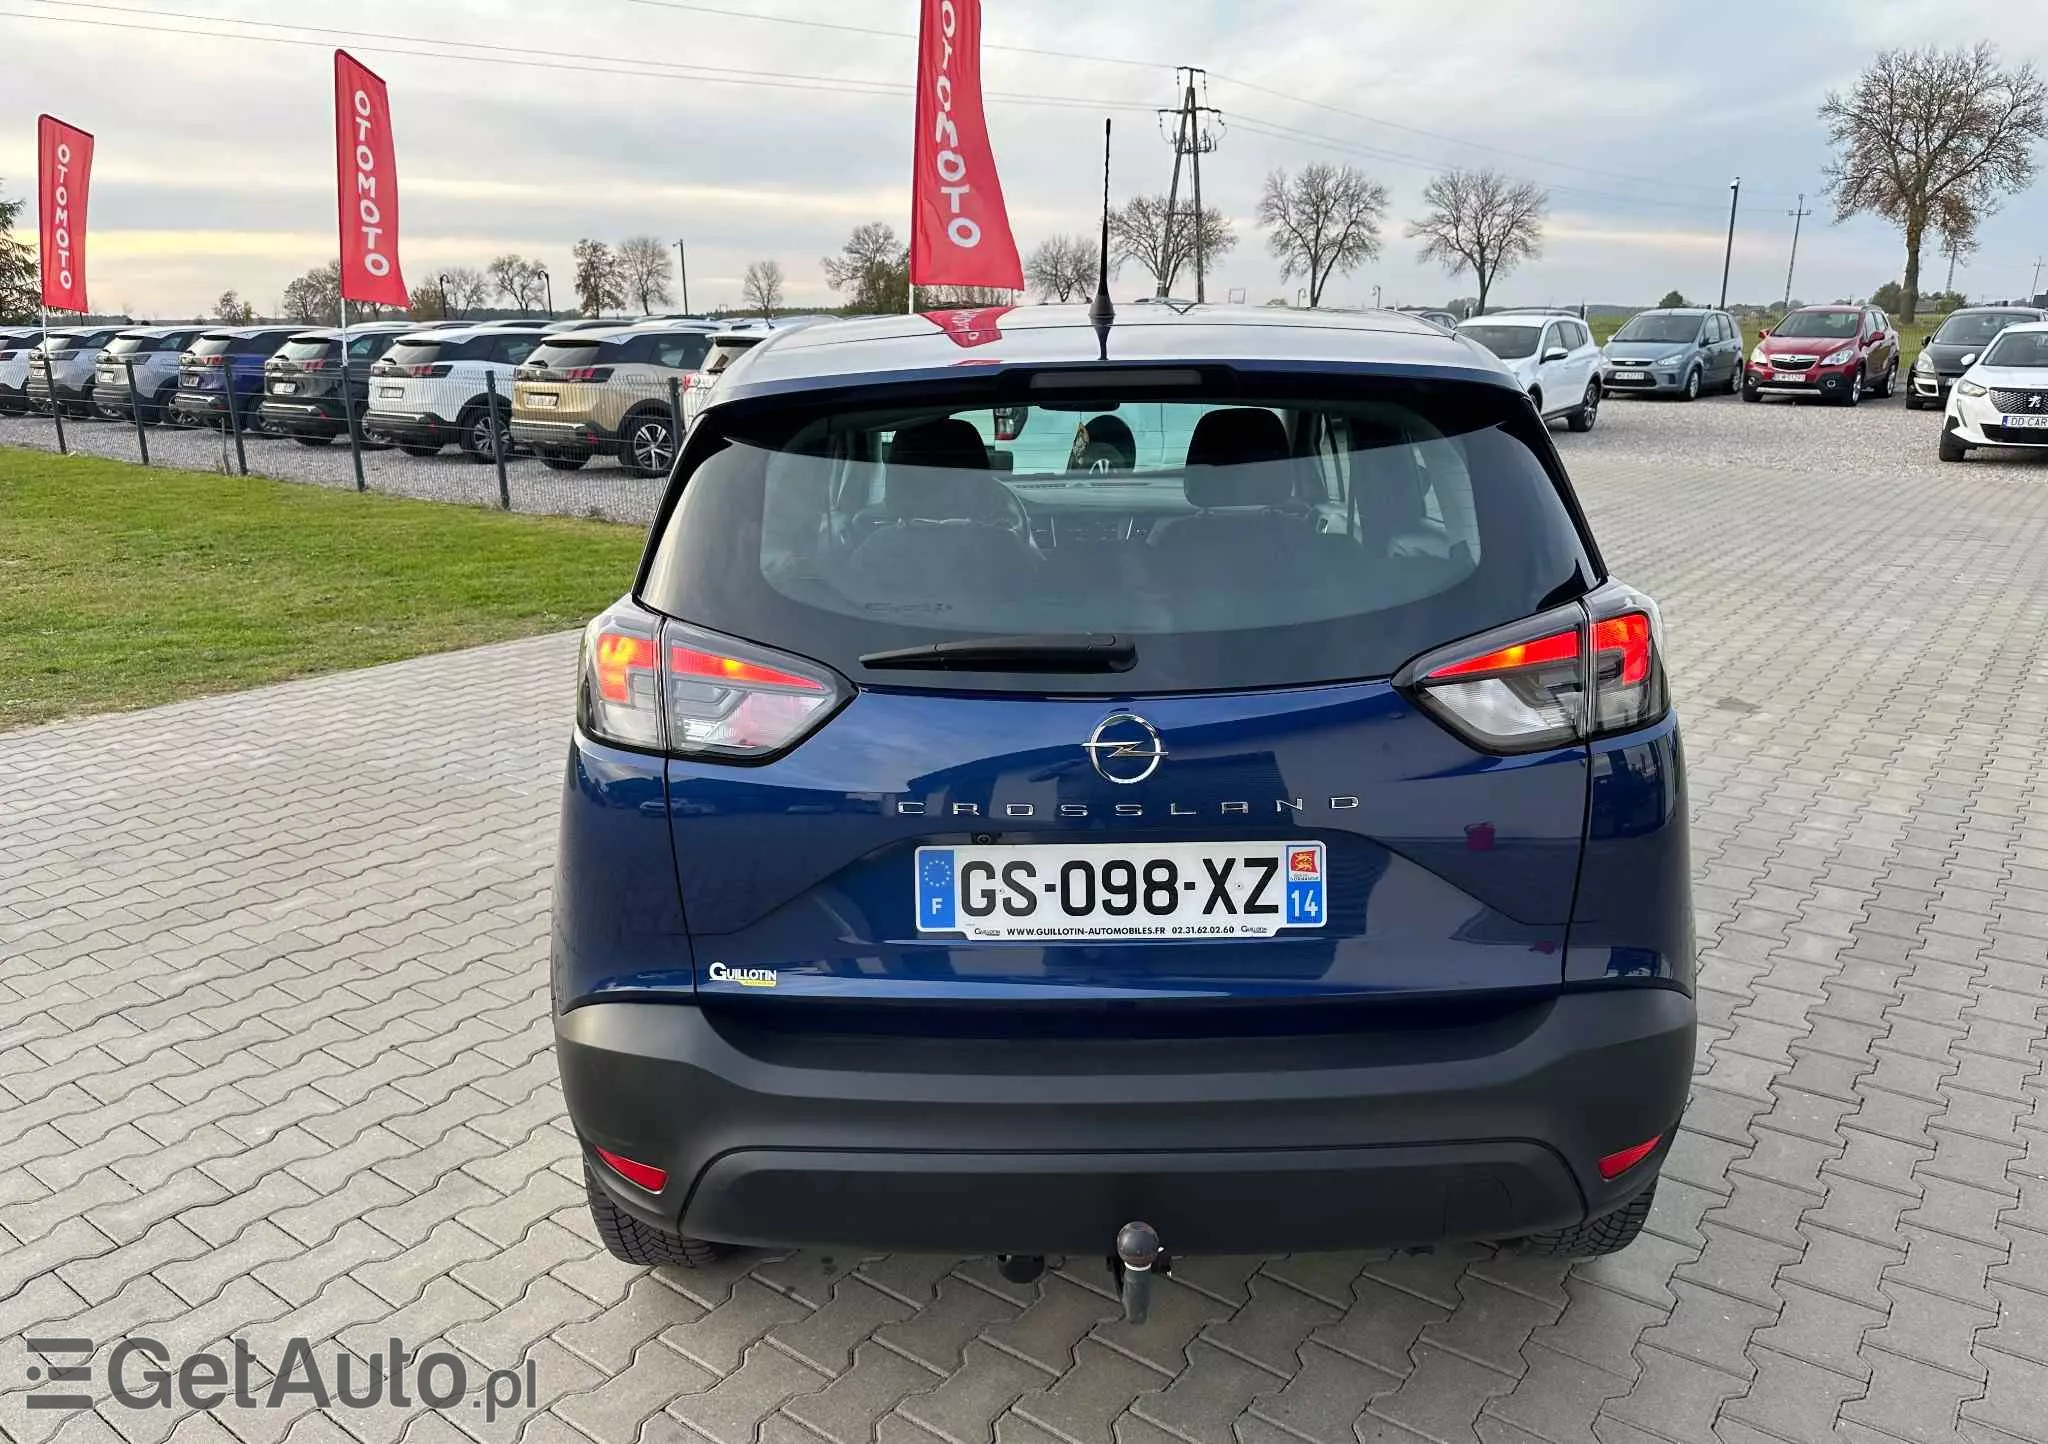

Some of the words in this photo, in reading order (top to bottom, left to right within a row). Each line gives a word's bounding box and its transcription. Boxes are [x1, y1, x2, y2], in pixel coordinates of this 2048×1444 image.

[935, 0, 981, 248] OTOMOTO
[354, 89, 390, 277] OTOMOTO
[56, 143, 72, 290] OTOMOTO
[897, 796, 1359, 816] CROSSLAND
[931, 897, 944, 915] F
[960, 857, 1280, 917] GS-098-XZ
[1290, 889, 1319, 917] 14
[1006, 926, 1166, 936] WWW.GUILLOTIN-AUTOMOBILES.FR
[1171, 926, 1235, 935] 02.31.62.02.60
